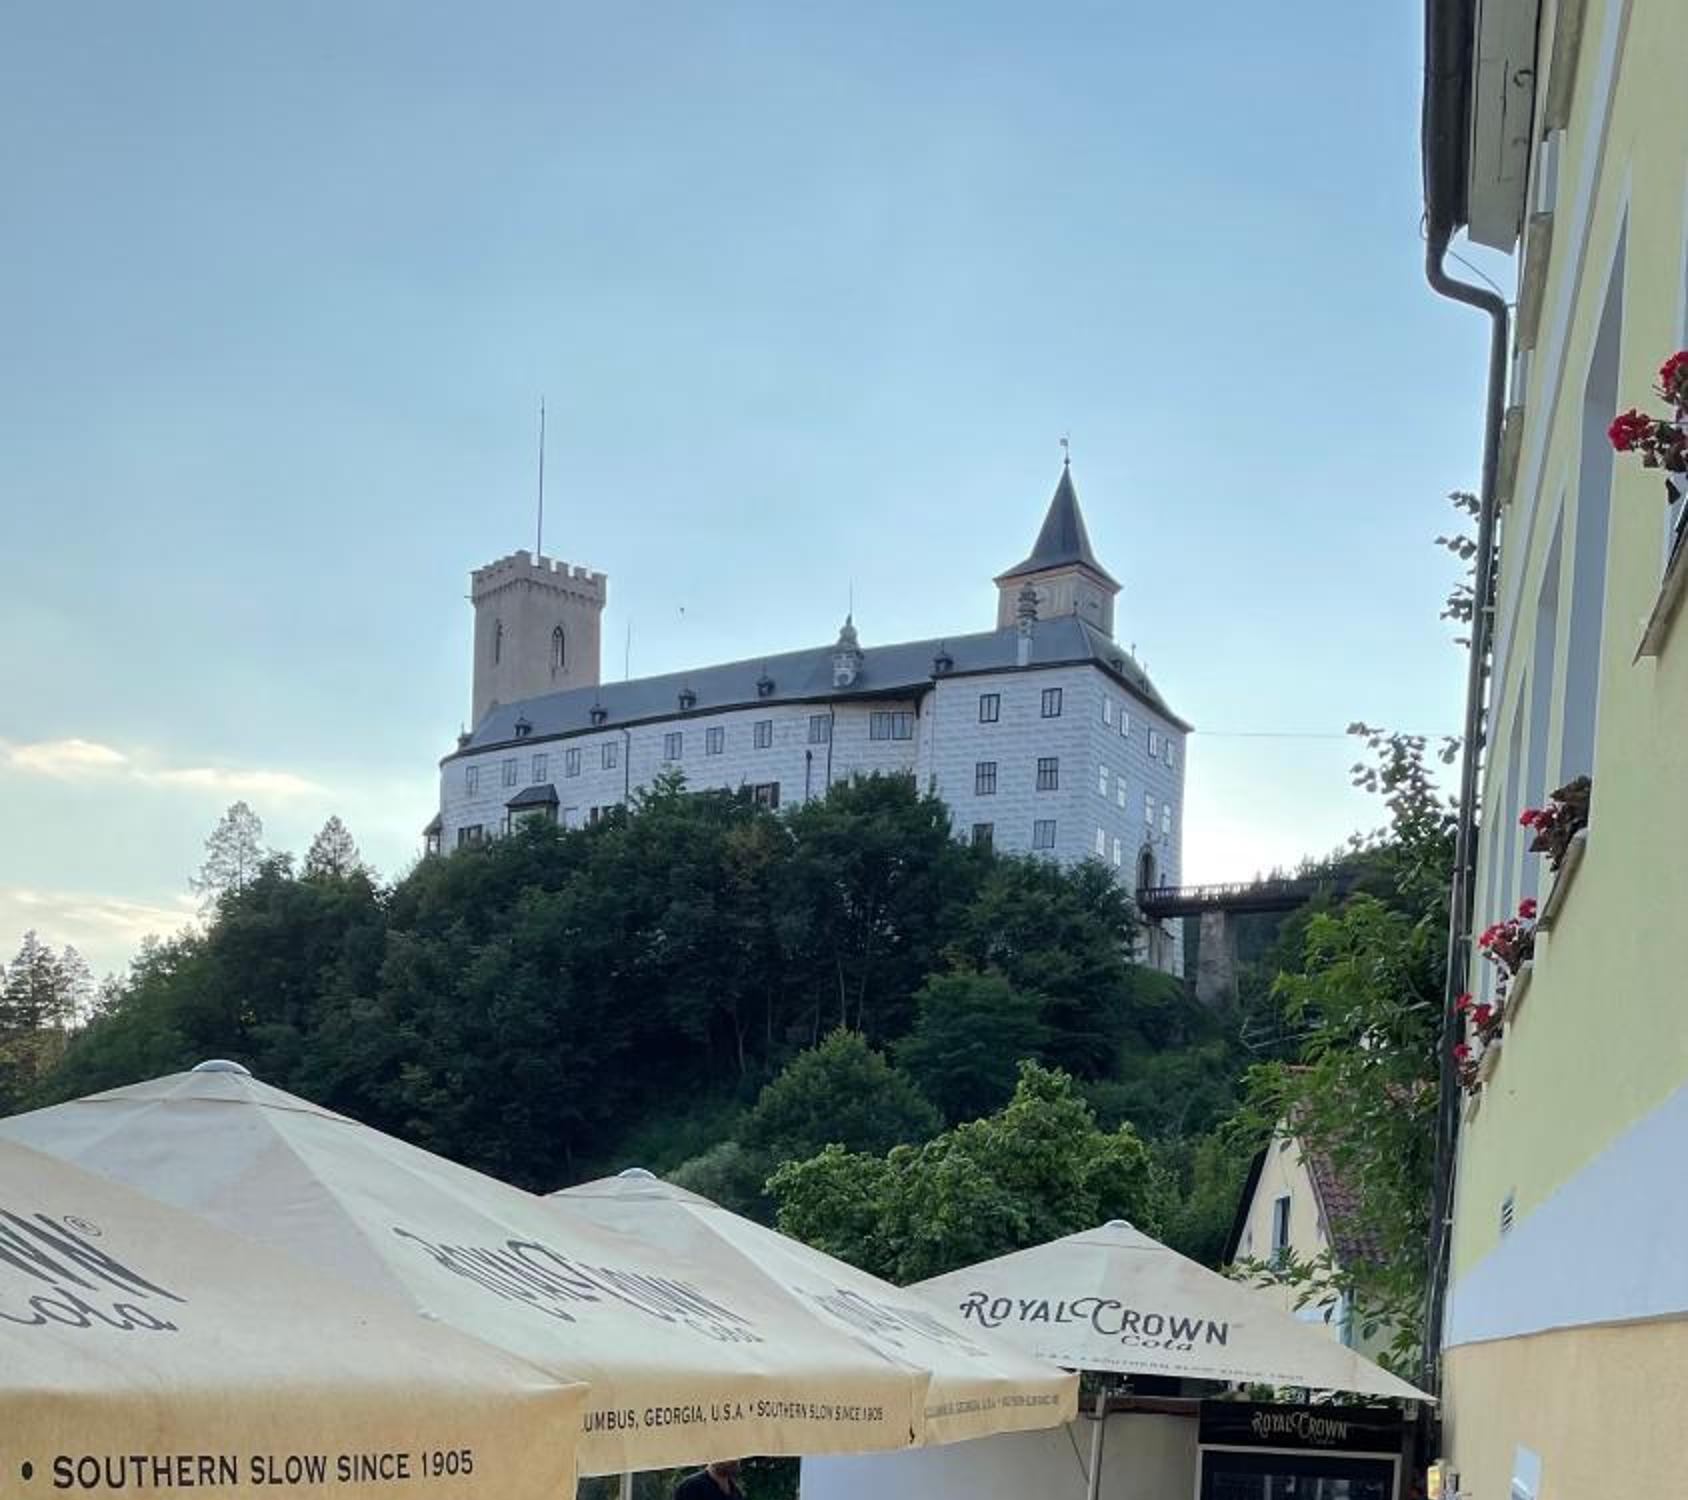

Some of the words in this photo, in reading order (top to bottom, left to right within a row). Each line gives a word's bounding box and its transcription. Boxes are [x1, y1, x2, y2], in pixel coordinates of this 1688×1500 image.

[959, 1291, 1073, 1328] ROYAL
[1069, 1297, 1229, 1346] CROWN
[1120, 1335, 1193, 1351] Cola
[582, 1409, 639, 1432] UMBUS,
[643, 1404, 707, 1427] GEORGIA,
[757, 1399, 806, 1419] SOUTHERN
[1250, 1411, 1293, 1439] ROYAL
[1291, 1411, 1347, 1439] CROWN
[53, 1455, 238, 1489] SOUTHERN
[250, 1454, 327, 1485] SLOW
[337, 1453, 410, 1482] SINCE
[420, 1450, 474, 1476] 1905
